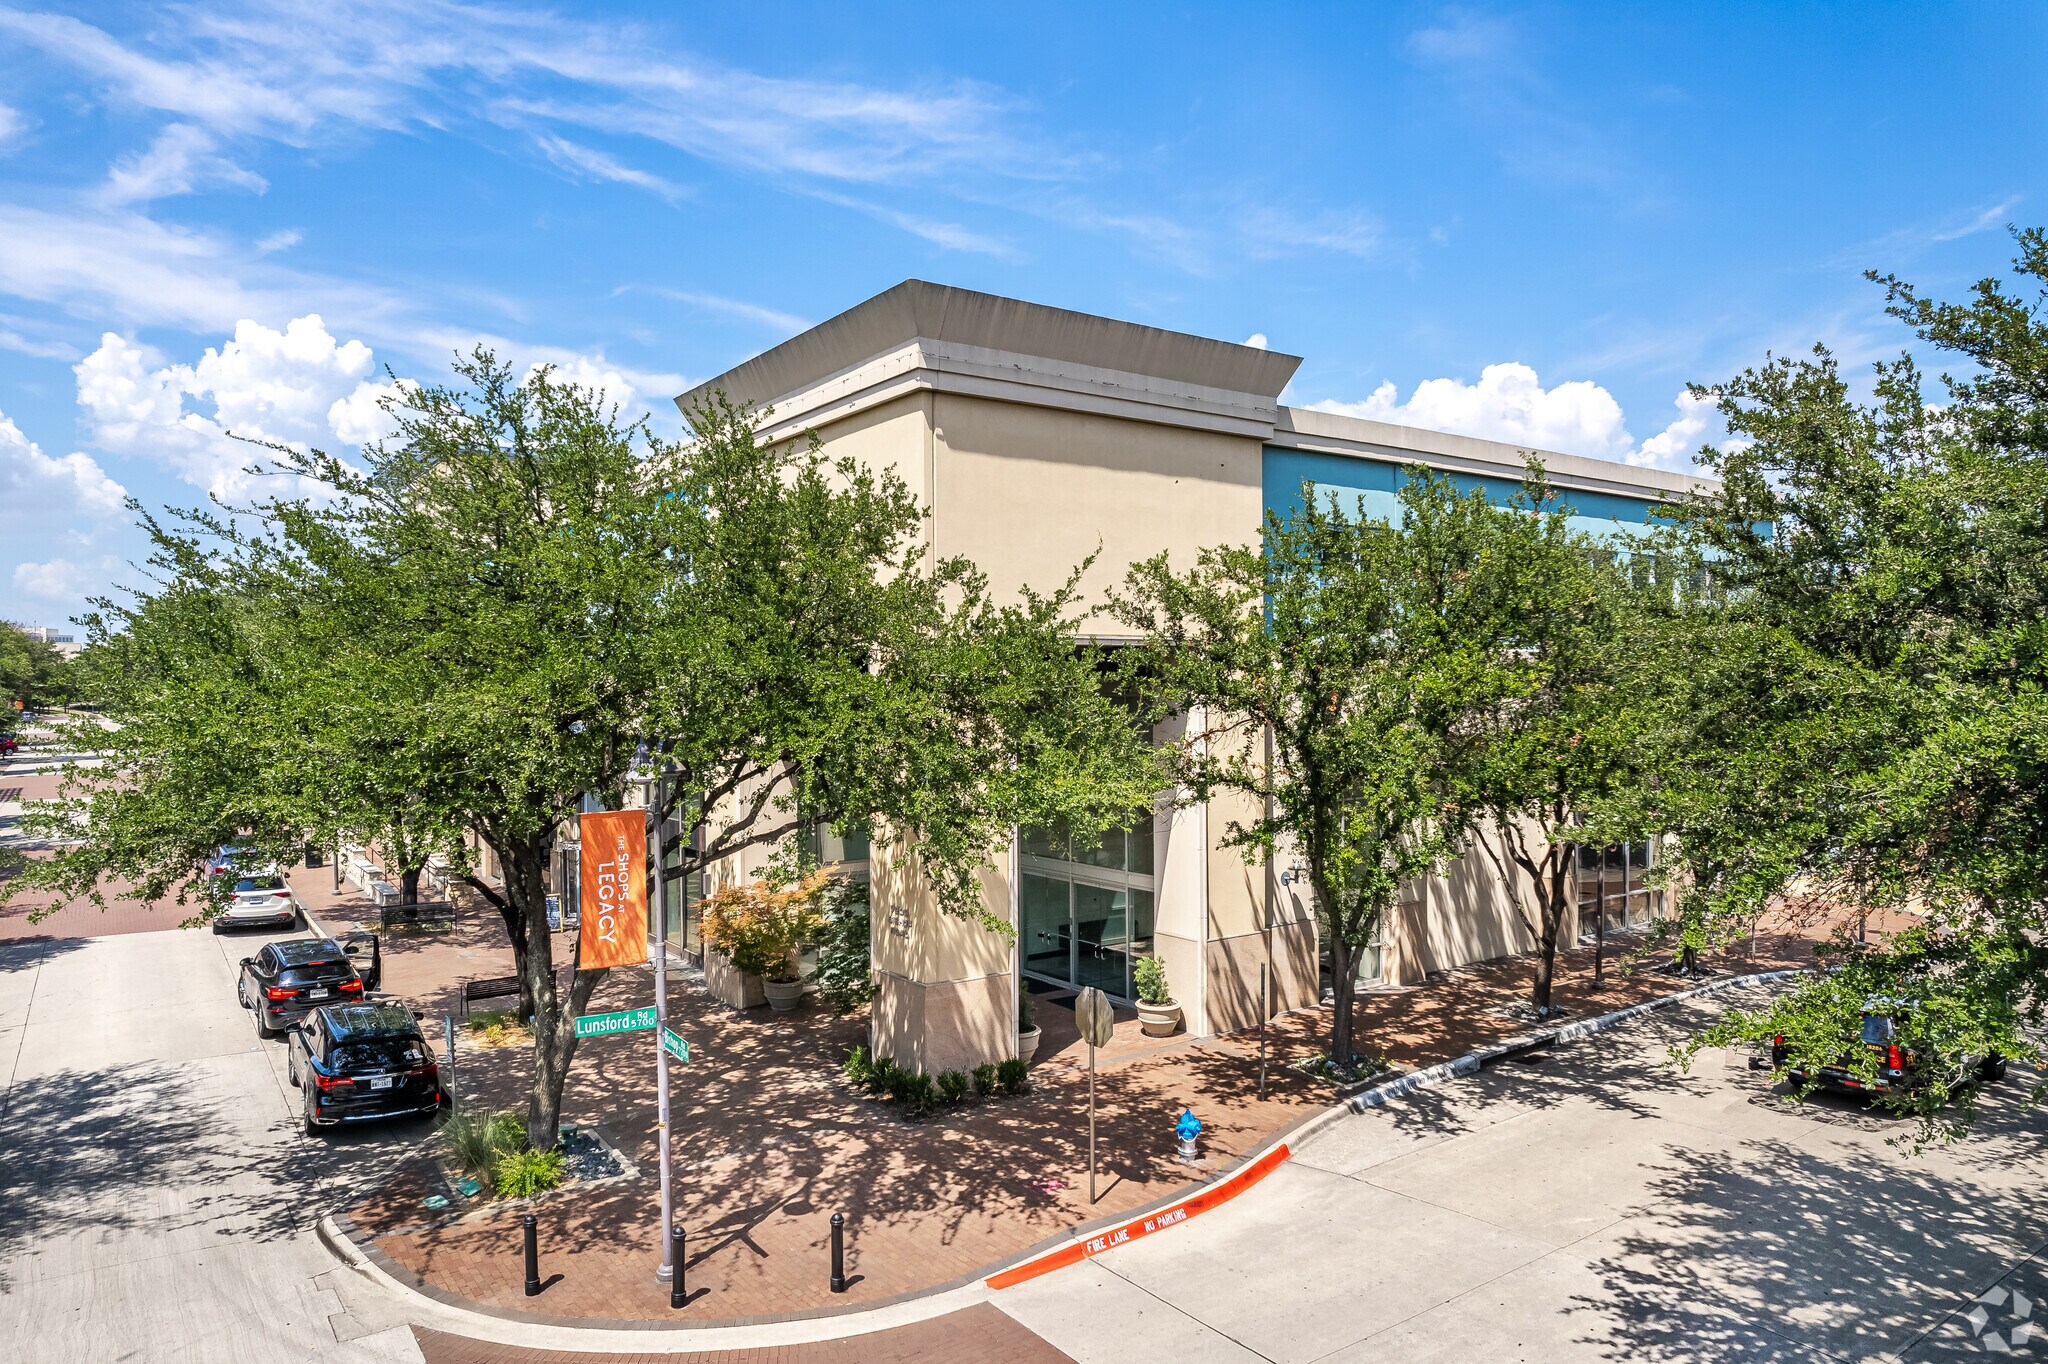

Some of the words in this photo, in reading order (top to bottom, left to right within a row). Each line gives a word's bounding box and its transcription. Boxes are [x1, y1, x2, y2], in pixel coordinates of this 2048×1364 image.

[617, 835, 625, 850] THE
[618, 853, 630, 901] SHOPS
[598, 861, 615, 943] LEGACY
[617, 904, 625, 914] AT
[577, 1014, 630, 1035] Lunsford
[637, 1011, 648, 1019] Rd
[631, 1018, 655, 1028] 5700
[1086, 1237, 1107, 1253] FIRE
[1108, 1229, 1130, 1246] LANE
[1143, 1220, 1156, 1233] NO
[1156, 1208, 1187, 1228] PARKING
